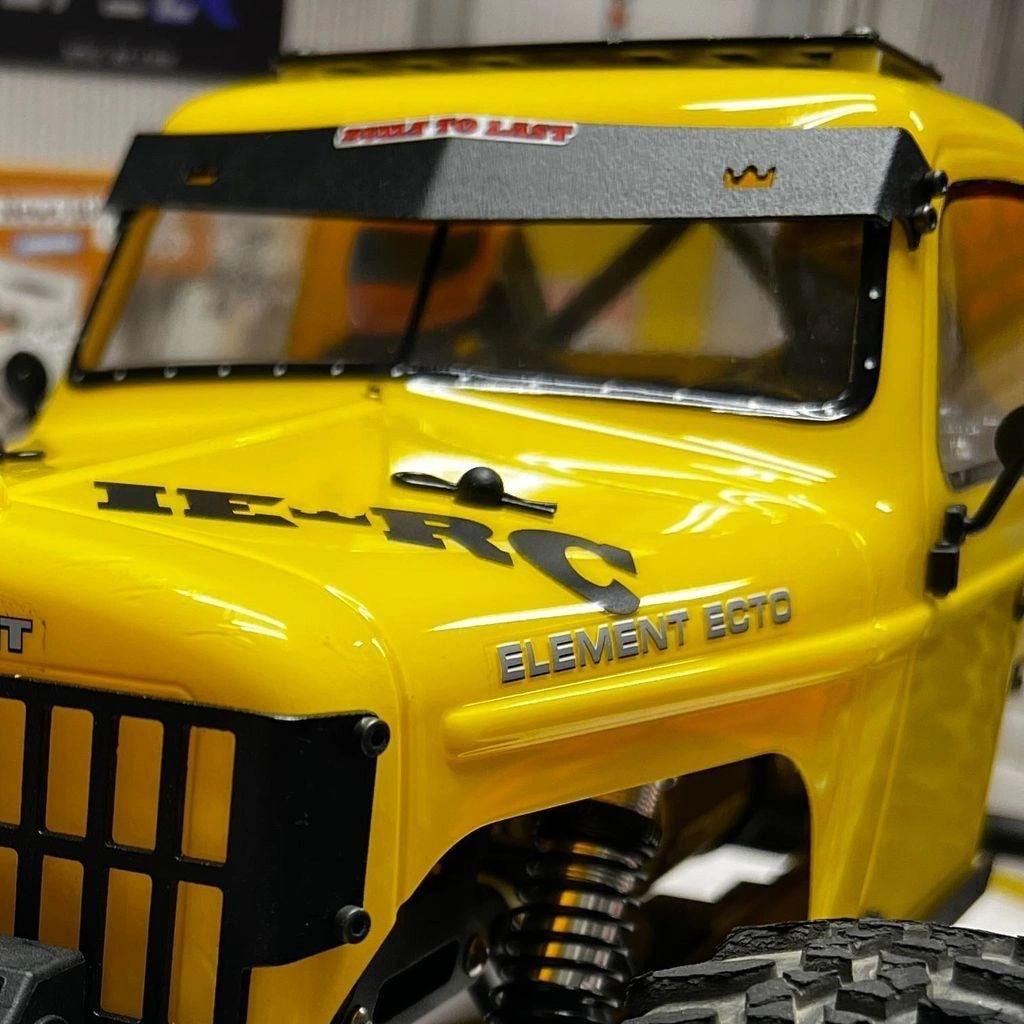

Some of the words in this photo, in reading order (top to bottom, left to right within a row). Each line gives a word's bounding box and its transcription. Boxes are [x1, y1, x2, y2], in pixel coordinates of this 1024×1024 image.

[436, 118, 478, 134] TO
[486, 120, 574, 142] LAST
[496, 608, 689, 683] ELEMENT
[702, 587, 793, 640] ECTO
